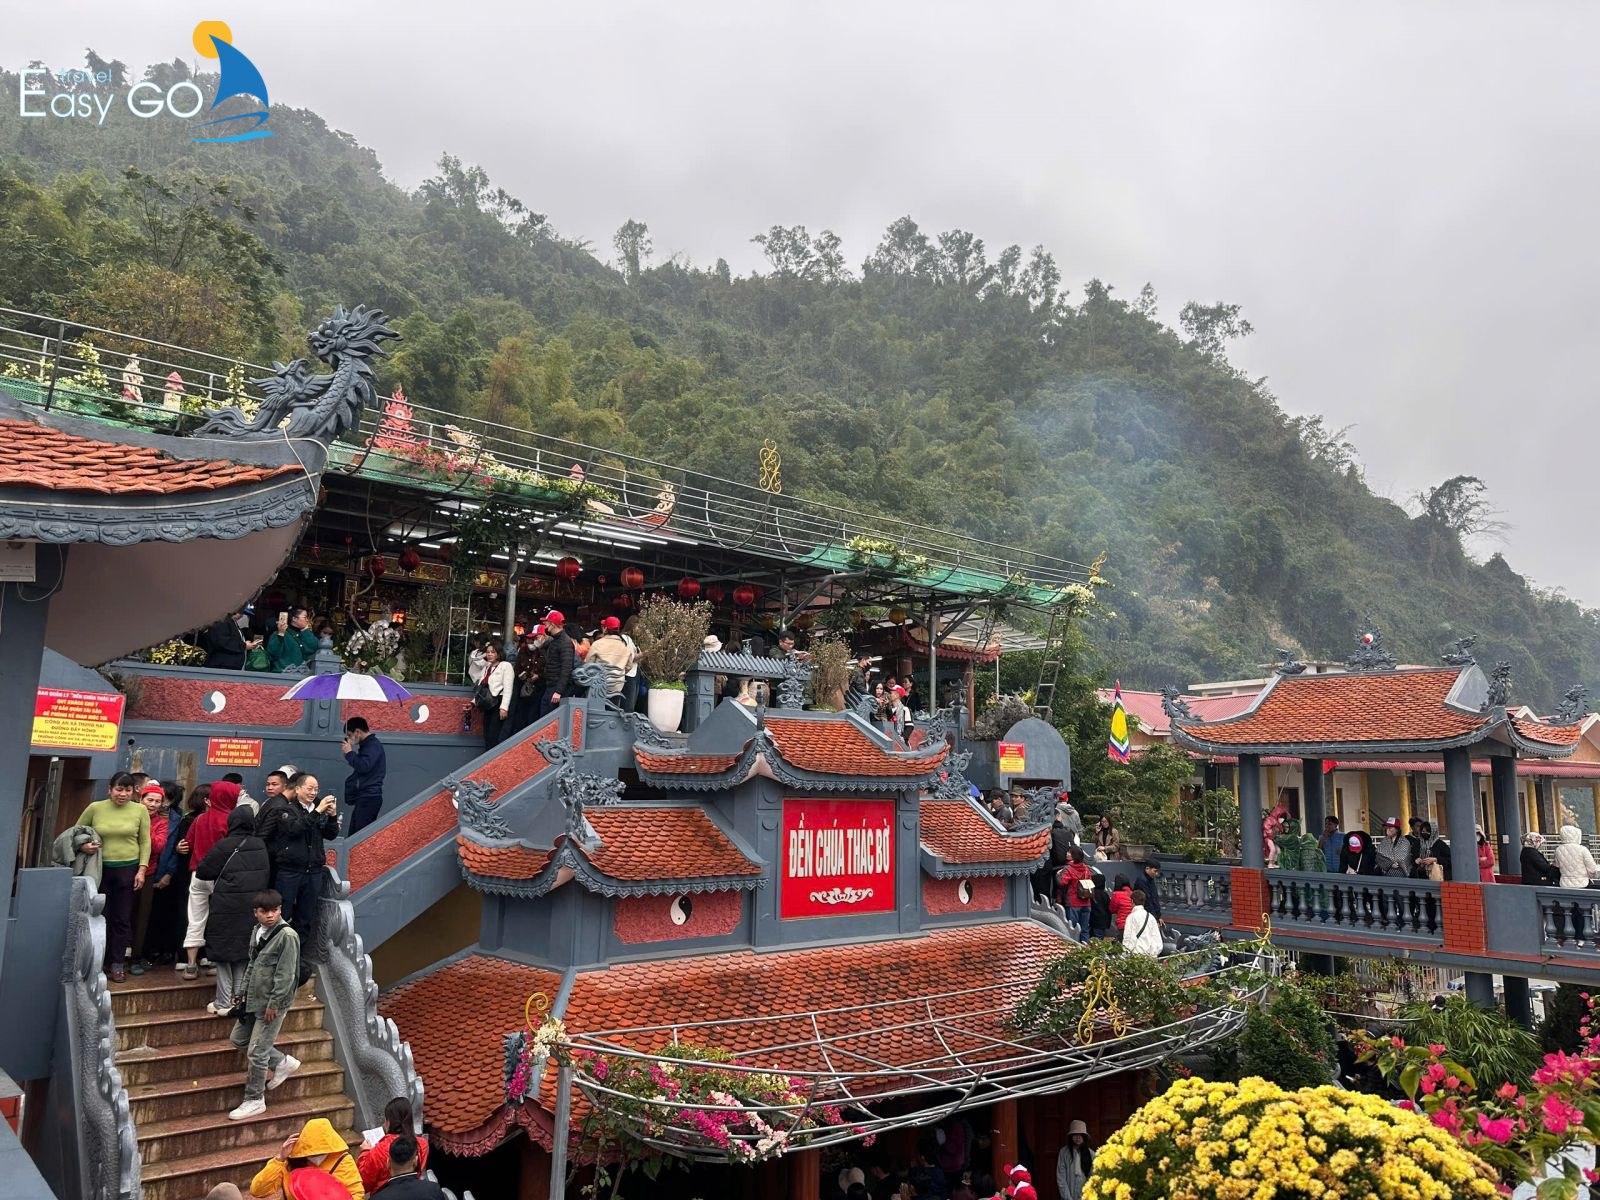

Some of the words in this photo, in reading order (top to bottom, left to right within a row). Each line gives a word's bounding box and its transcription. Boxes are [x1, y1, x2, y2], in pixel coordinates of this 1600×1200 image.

[789, 812, 813, 878] ĐỀN
[816, 818, 845, 877] CHÚA
[847, 818, 874, 875] THÁC
[876, 818, 890, 874] BỜ
